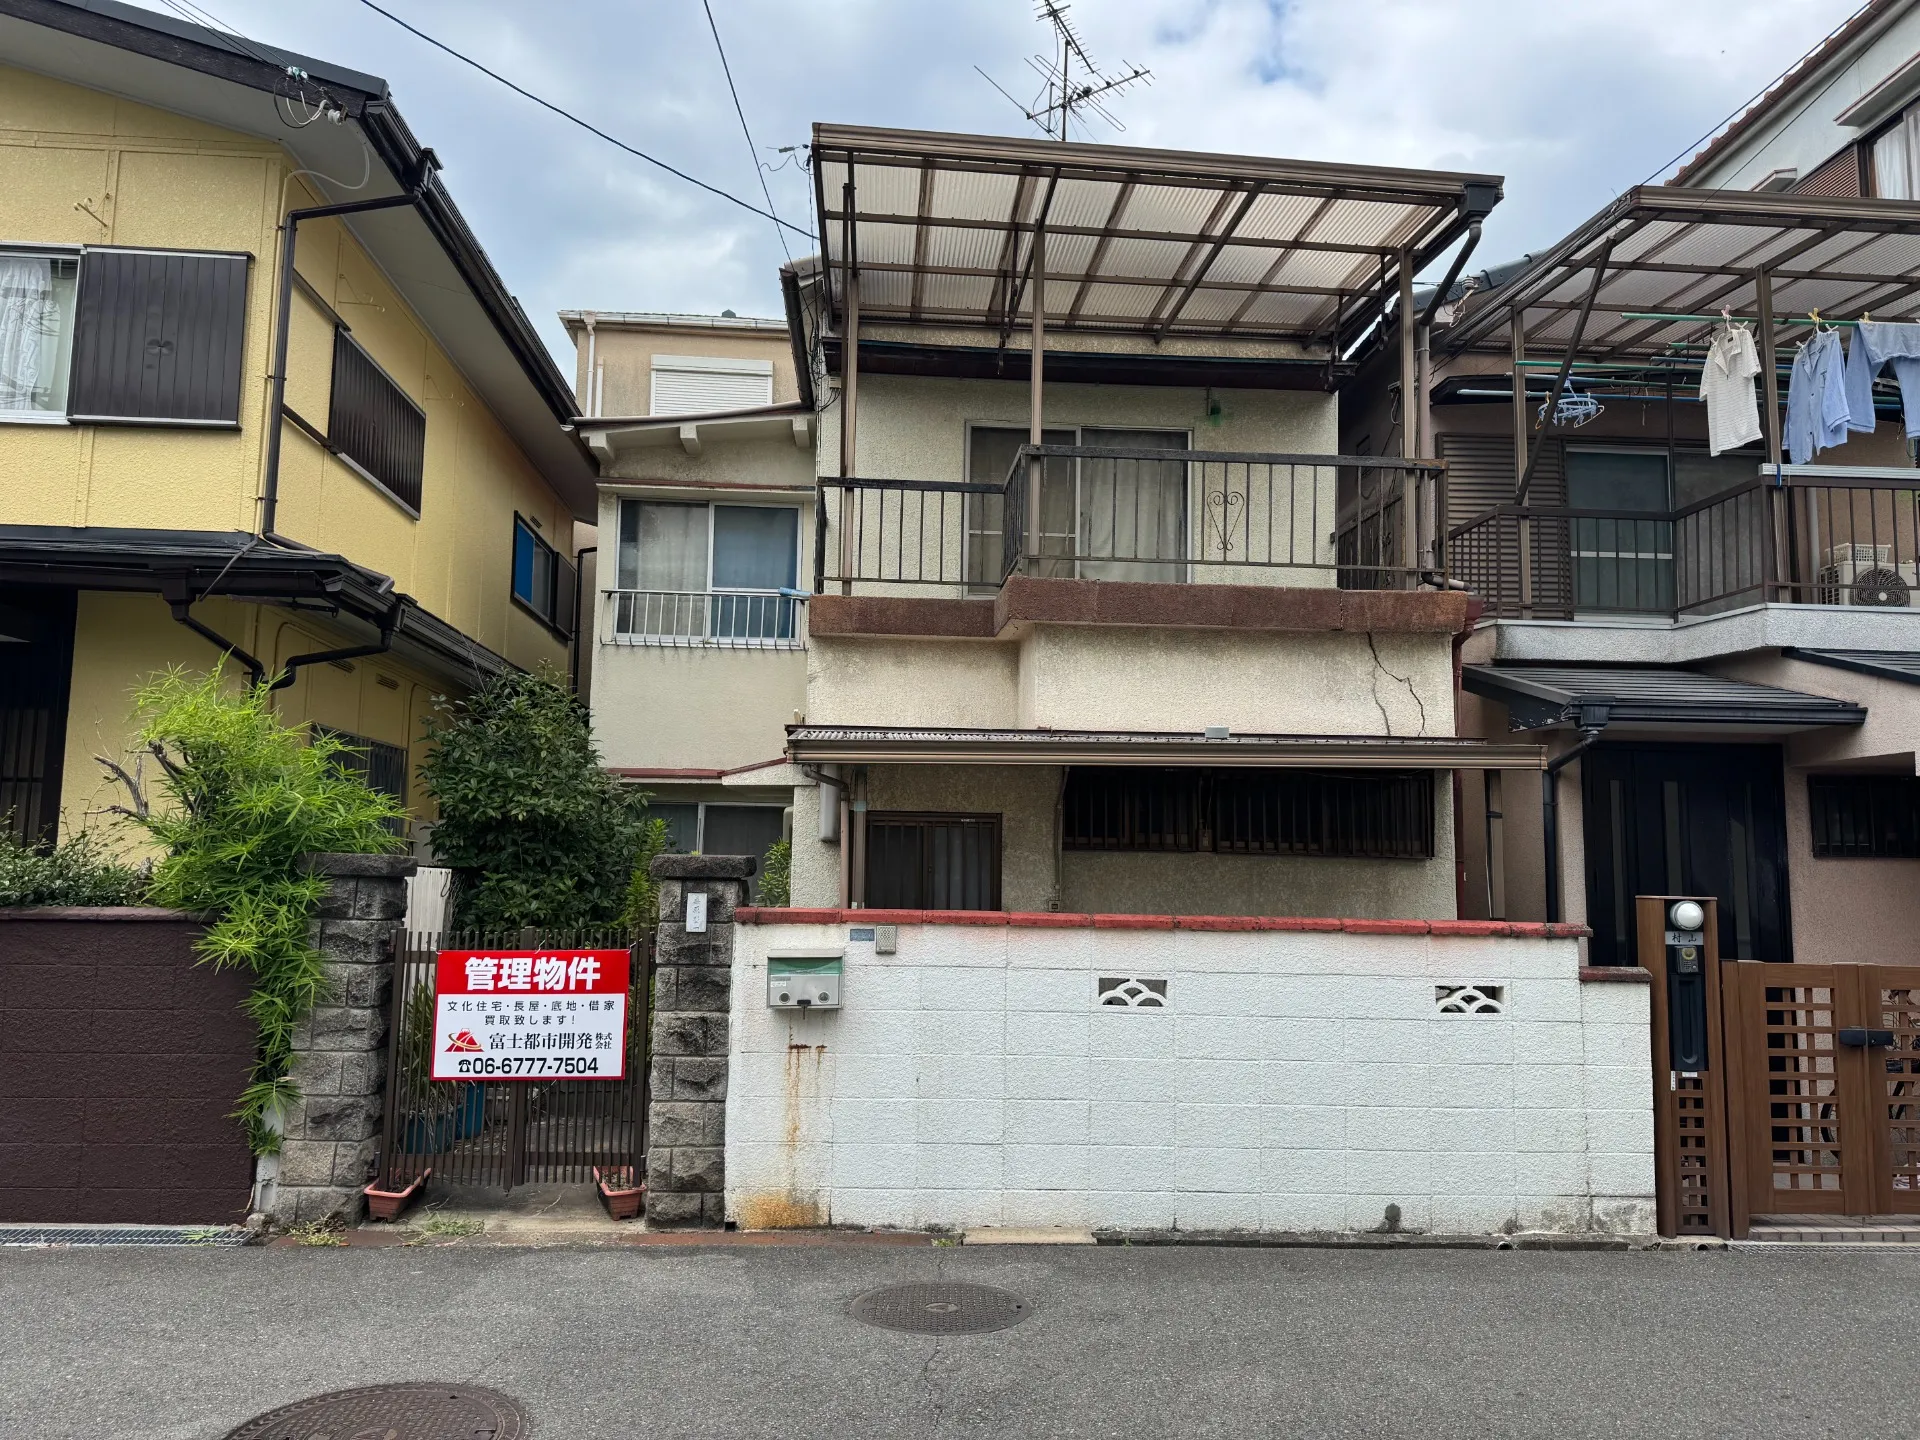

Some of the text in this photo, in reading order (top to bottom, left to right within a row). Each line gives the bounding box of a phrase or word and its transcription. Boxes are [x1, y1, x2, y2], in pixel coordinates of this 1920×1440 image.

[465, 957, 600, 991] 管理物件
[489, 1032, 593, 1050] 富士都市開発
[472, 1057, 599, 1074] 06-6777-7504
